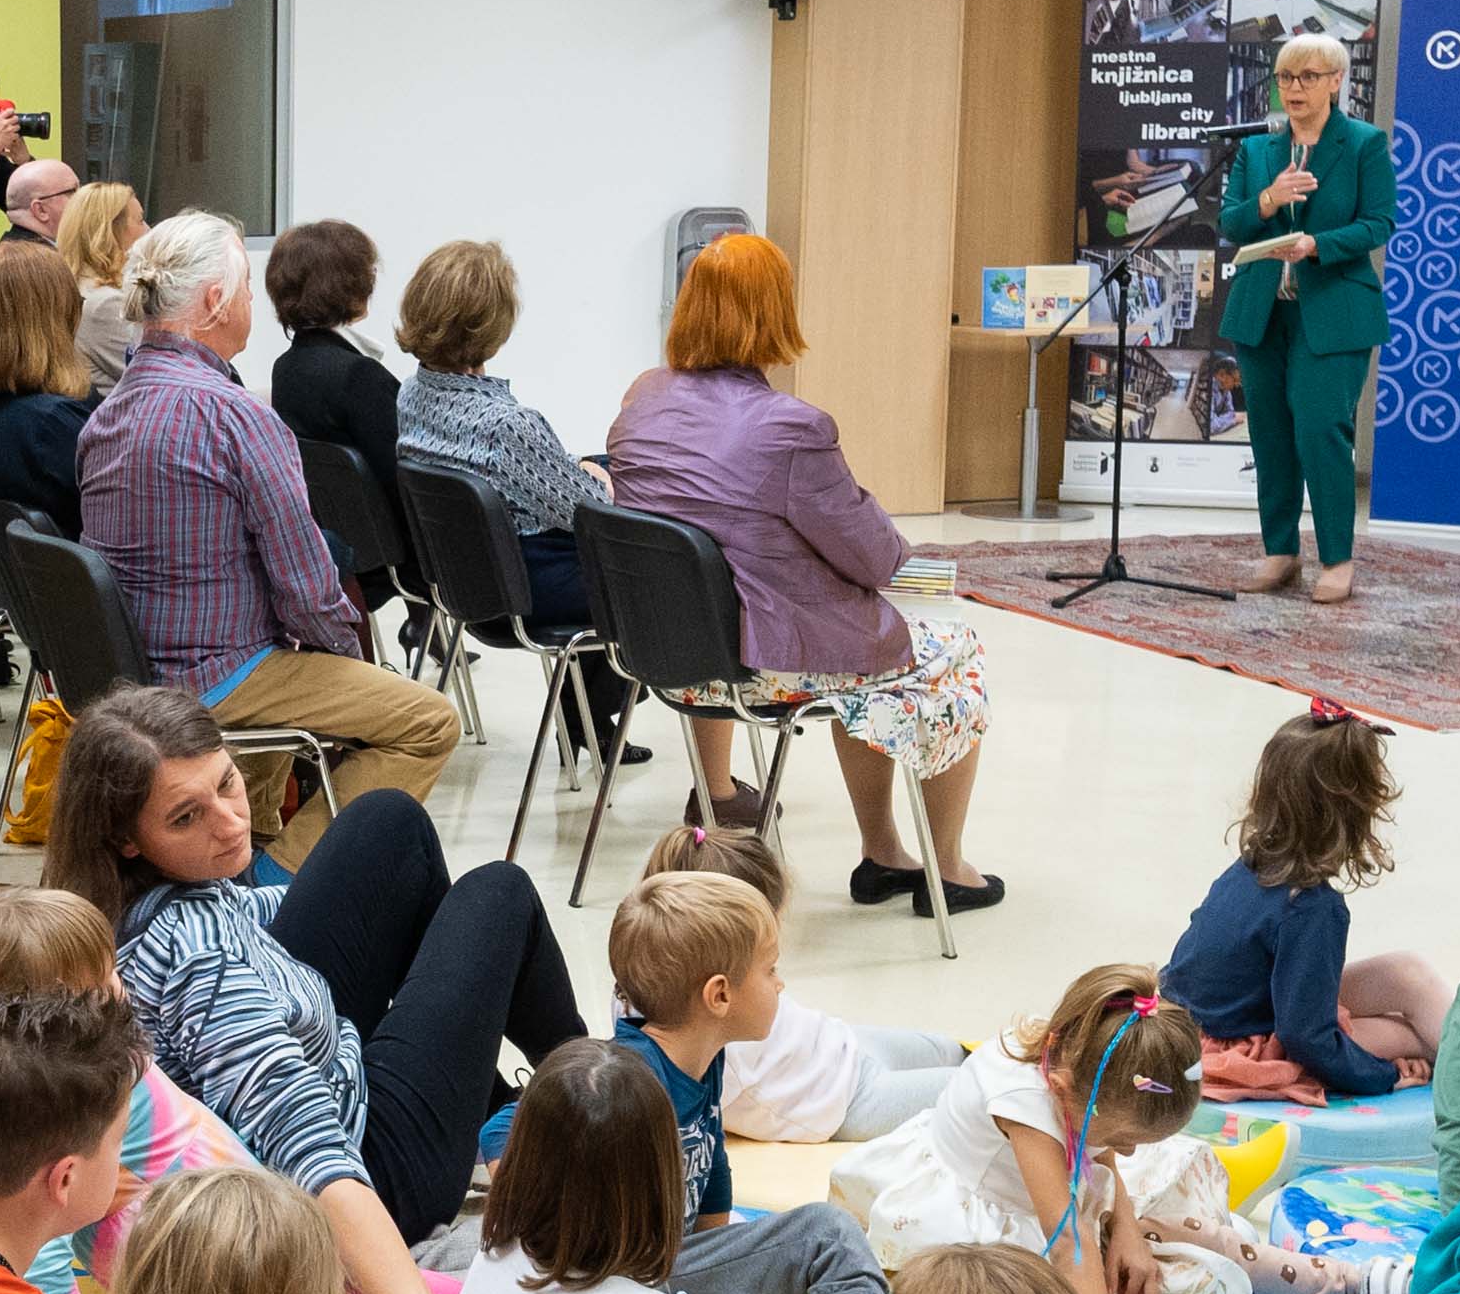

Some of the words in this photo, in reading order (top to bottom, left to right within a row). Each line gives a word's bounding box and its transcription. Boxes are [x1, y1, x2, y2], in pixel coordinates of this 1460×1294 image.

[1092, 50, 1156, 63] mestna
[1091, 66, 1194, 87] knjižnica
[1119, 90, 1193, 106] ljubljana
[1180, 107, 1214, 124] city
